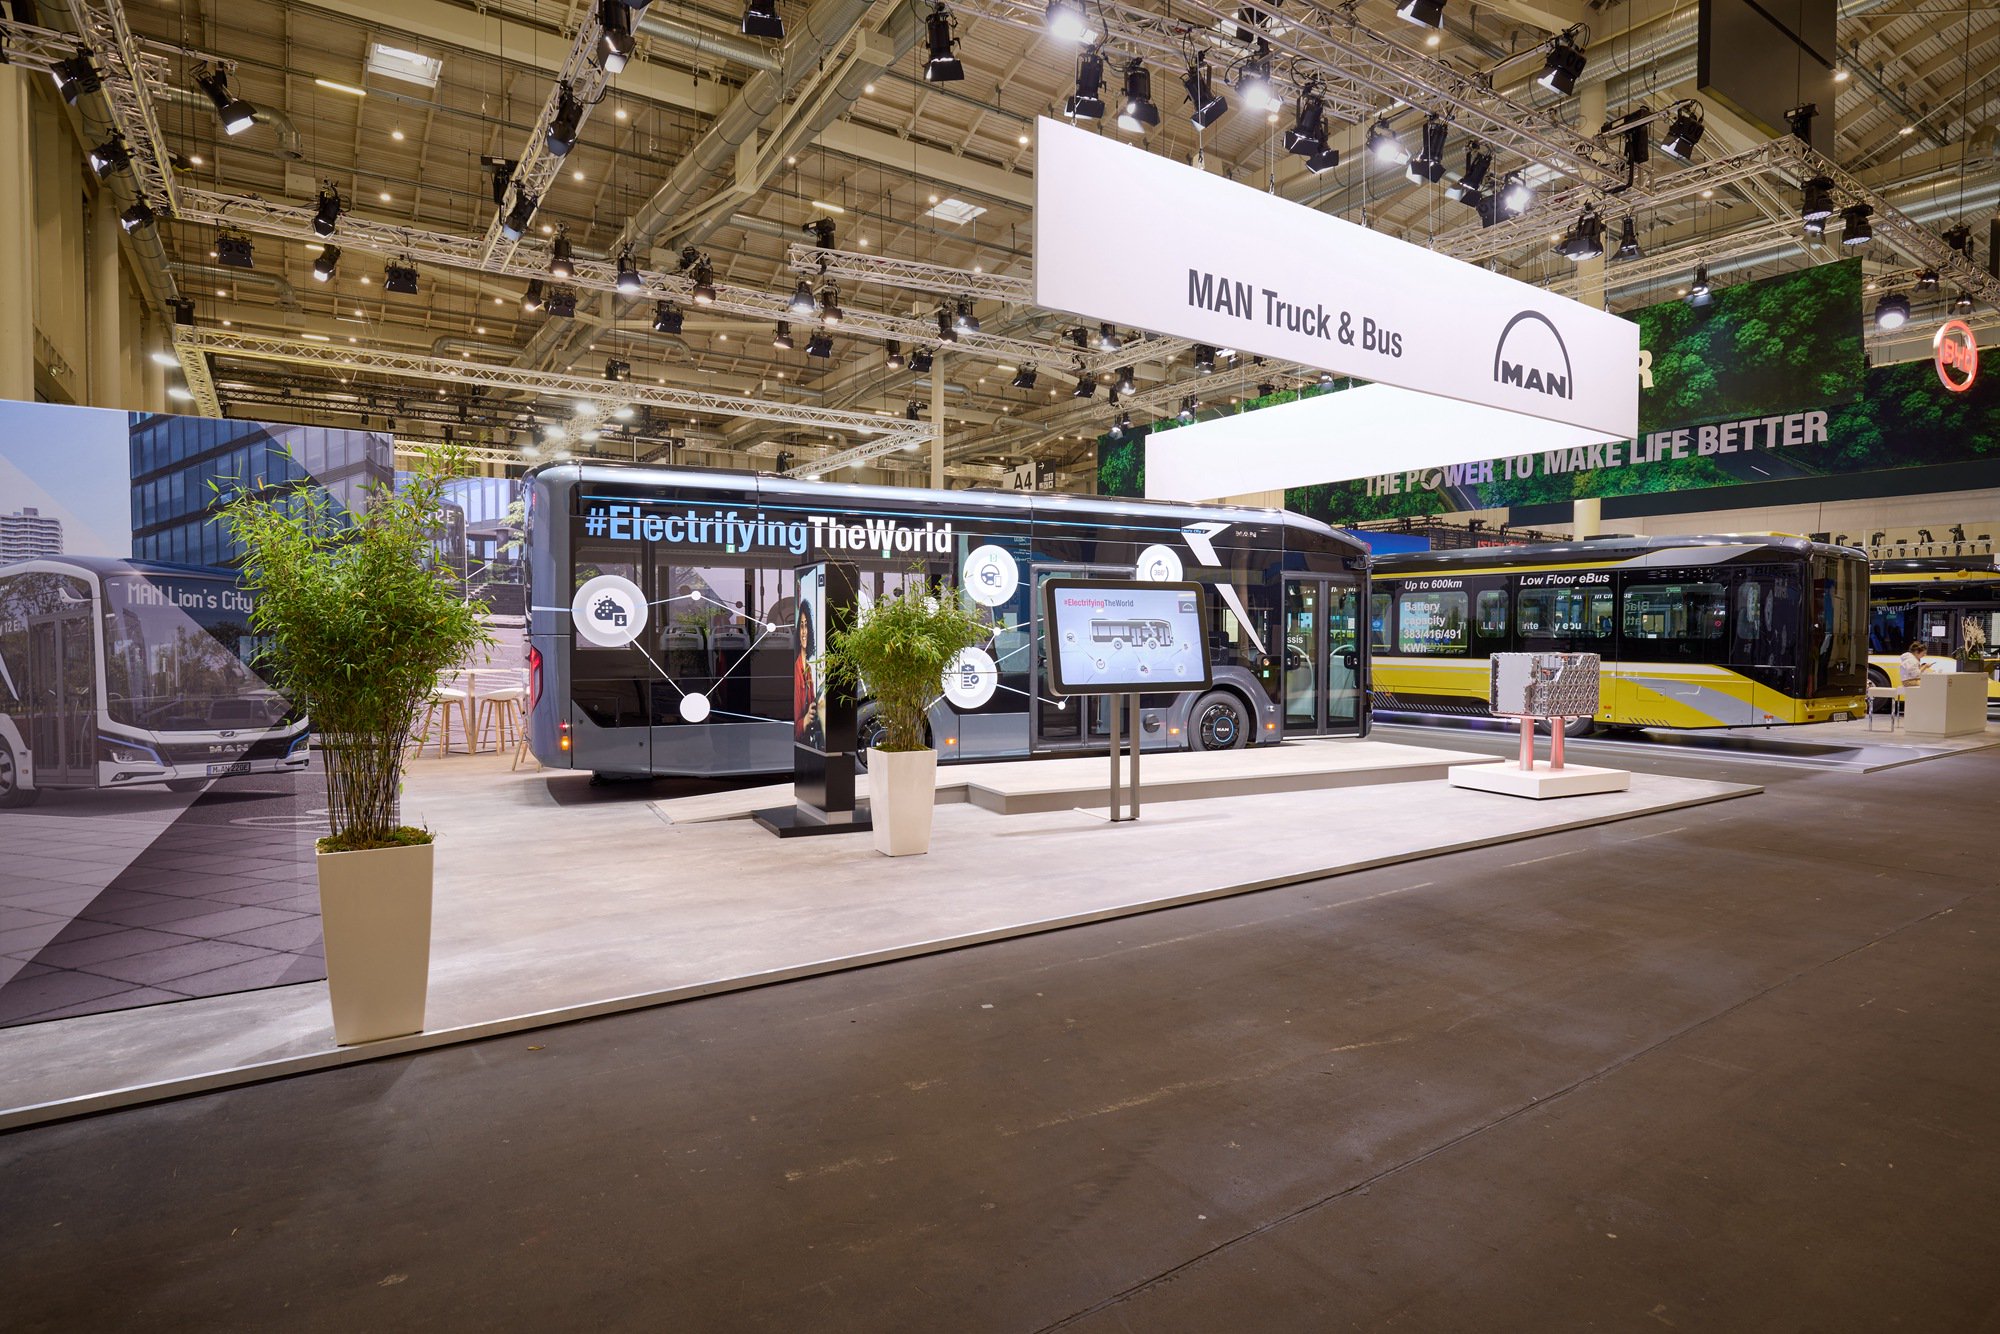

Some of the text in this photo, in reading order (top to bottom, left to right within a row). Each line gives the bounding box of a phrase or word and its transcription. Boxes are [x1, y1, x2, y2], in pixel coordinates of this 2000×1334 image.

[1188, 268, 1403, 358] MAN Truck & Bus
[1502, 360, 1566, 398] MAN
[1365, 472, 1400, 497] THE
[1501, 454, 1534, 481] TO
[1543, 442, 1622, 475] MAKE
[1630, 428, 1690, 465] LIFE
[1698, 410, 1828, 456] BETTER
[1013, 471, 1032, 490] A4
[585, 505, 952, 553] #ElectrifyingTheWorld
[1404, 579, 1463, 591] Up to 600km
[1520, 573, 1610, 586] Low Floor eBus
[128, 583, 163, 606] MAN
[168, 586, 217, 609] Lion's
[221, 590, 254, 614] City
[1064, 598, 1134, 609] #ElectrifyingTheWorld
[1404, 602, 1440, 613] Battery
[1404, 616, 1445, 627] capacity
[1404, 629, 1462, 640] 383/416/491
[1404, 643, 1427, 653] KWh
[209, 743, 249, 753] MAN
